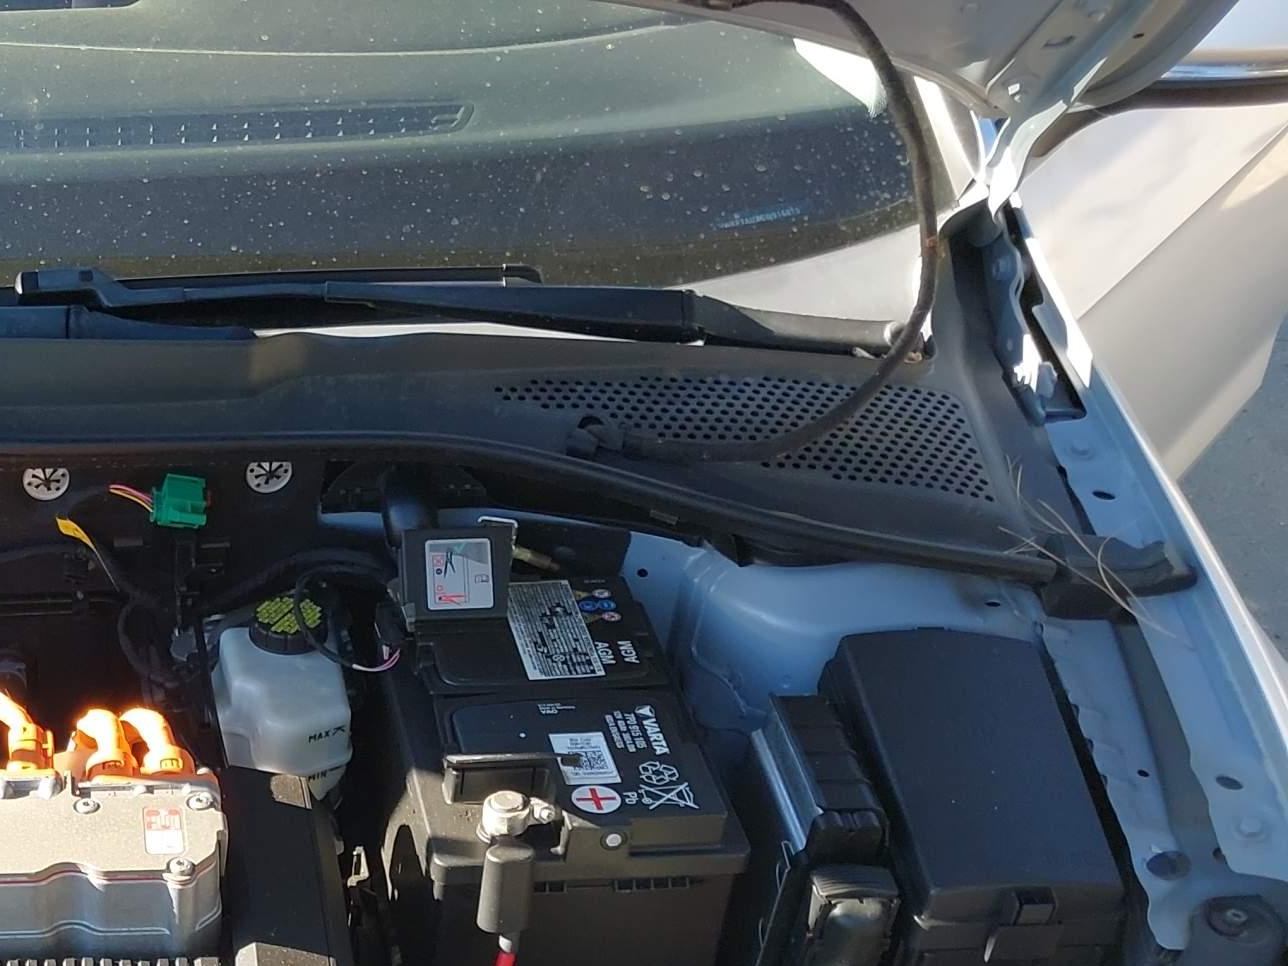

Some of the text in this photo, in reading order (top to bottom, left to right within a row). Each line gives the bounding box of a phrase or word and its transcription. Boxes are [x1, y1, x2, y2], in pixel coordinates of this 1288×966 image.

[595, 641, 616, 665] AGM
[617, 640, 640, 664] AGM
[308, 730, 329, 743] MAX
[642, 717, 670, 755] VARTA
[307, 771, 327, 783] MIN
[623, 791, 637, 805] Pb
